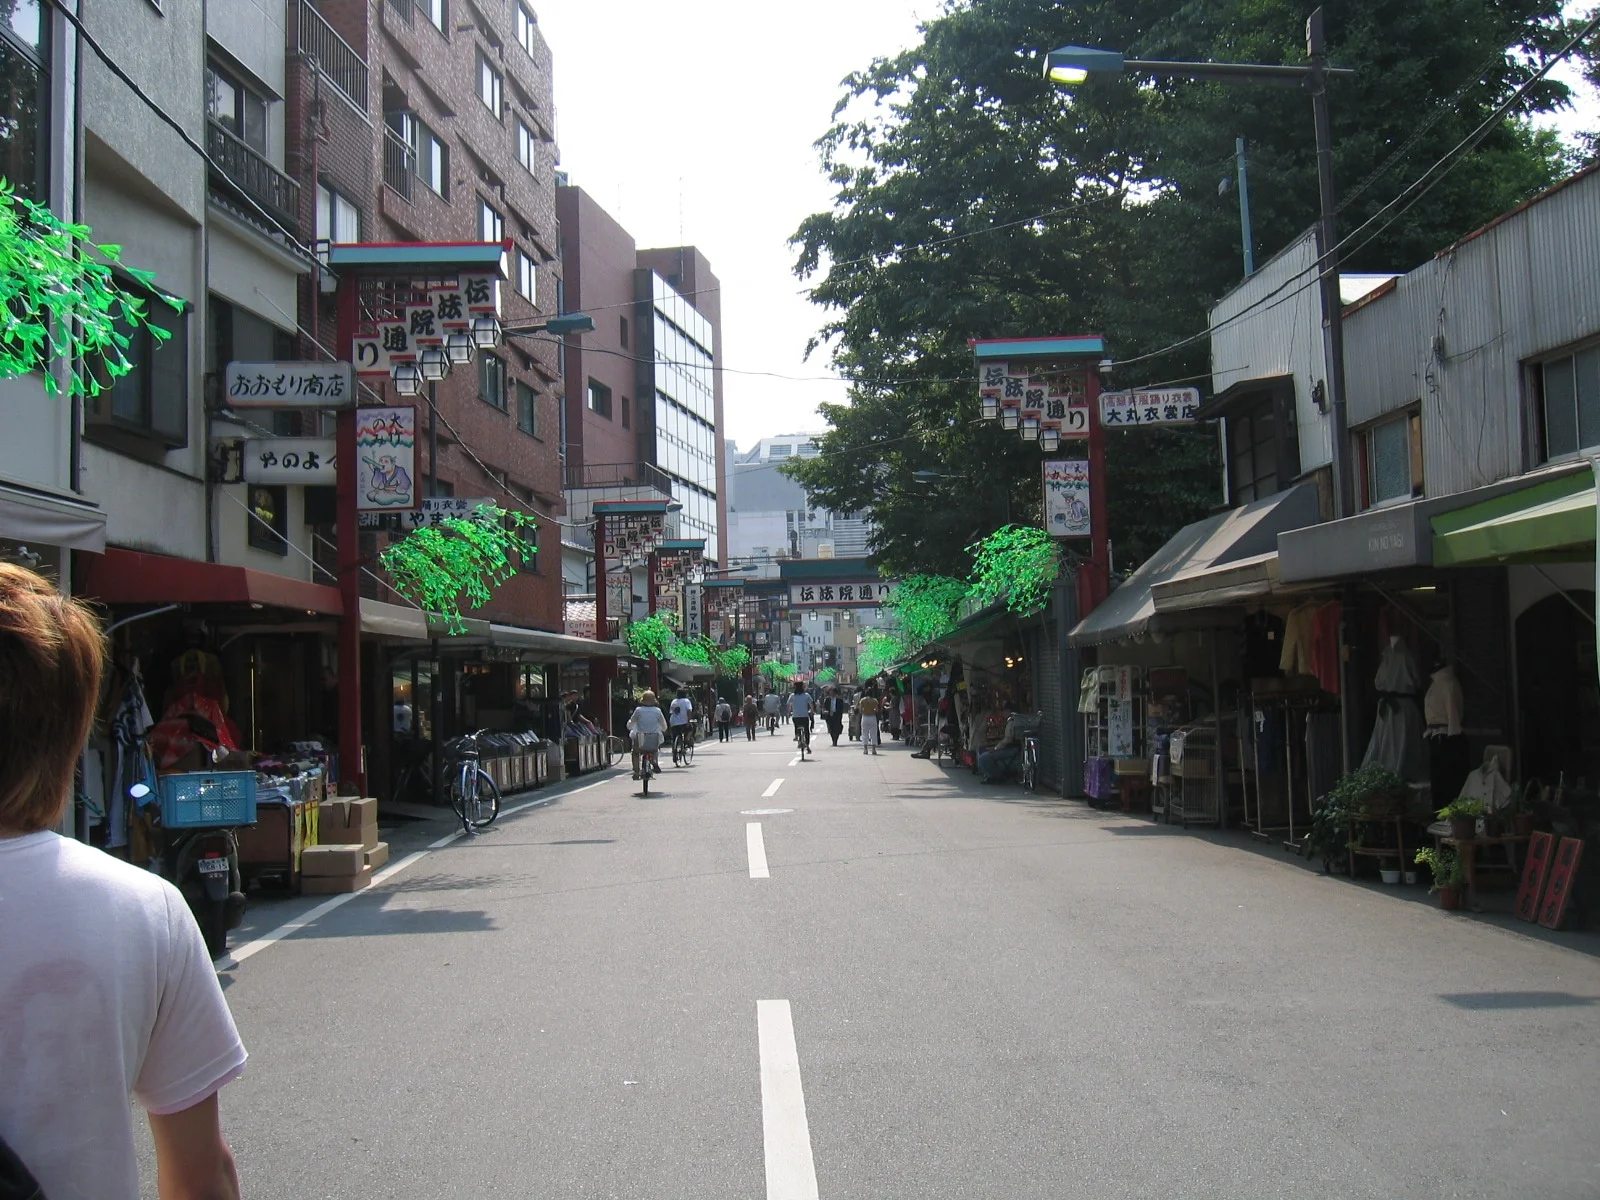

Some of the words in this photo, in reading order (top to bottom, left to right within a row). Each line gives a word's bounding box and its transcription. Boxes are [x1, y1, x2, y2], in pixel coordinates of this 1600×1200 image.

[357, 278, 490, 367] 伝法院通り
[230, 373, 344, 397] おおもり商店
[985, 367, 1085, 430] 伝法院通り
[800, 584, 891, 602] 伝法院通り
